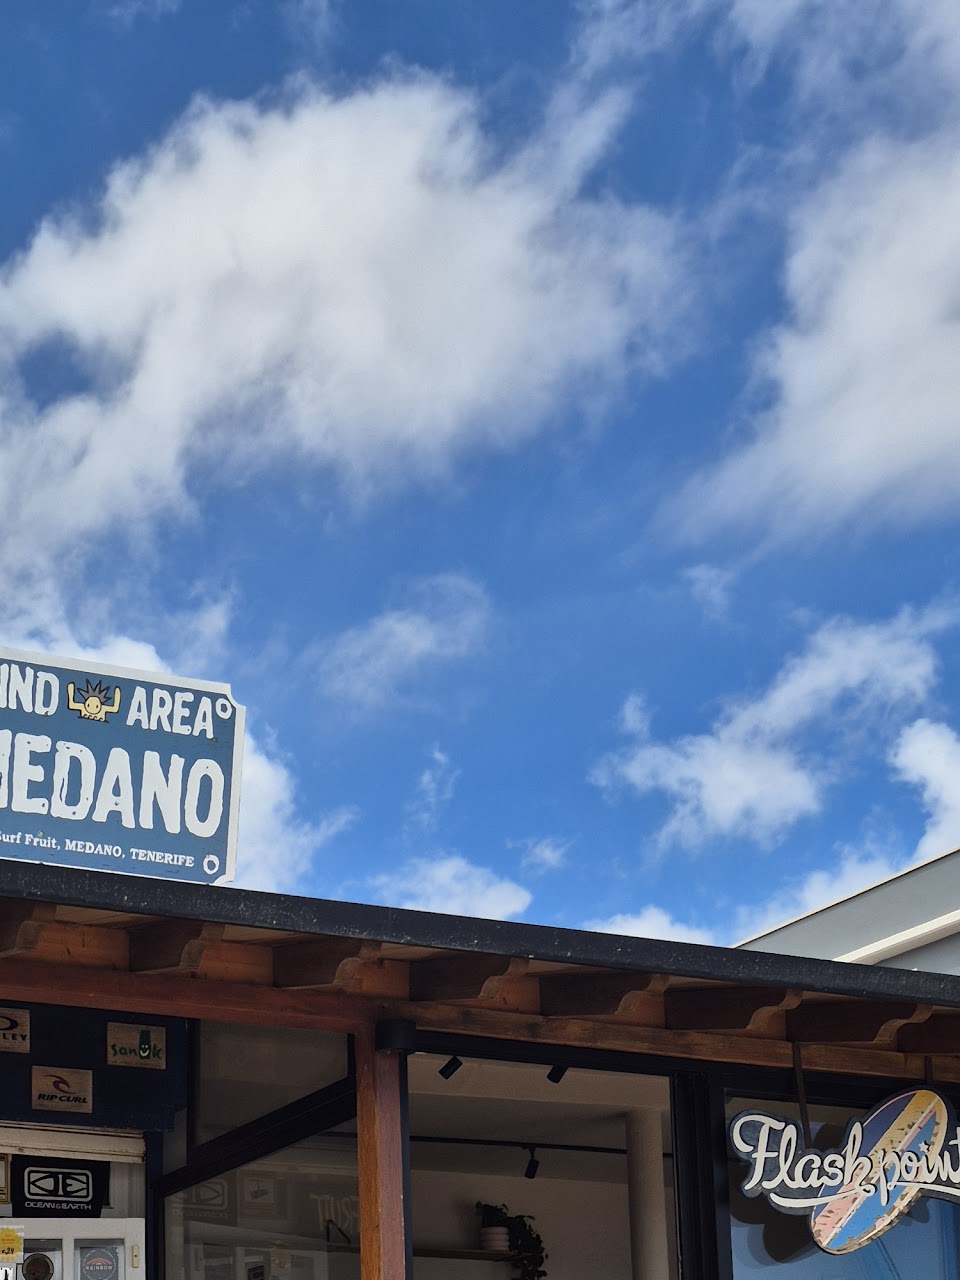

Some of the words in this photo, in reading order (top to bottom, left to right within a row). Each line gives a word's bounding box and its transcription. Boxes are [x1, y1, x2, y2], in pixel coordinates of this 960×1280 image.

[126, 686, 214, 738] AREA
[25, 833, 61, 850] Fruit,
[65, 839, 125, 859] MEDANO,
[130, 848, 195, 867] TENERIFE
[37, 1093, 57, 1101] RIP
[59, 1095, 88, 1103] CURL
